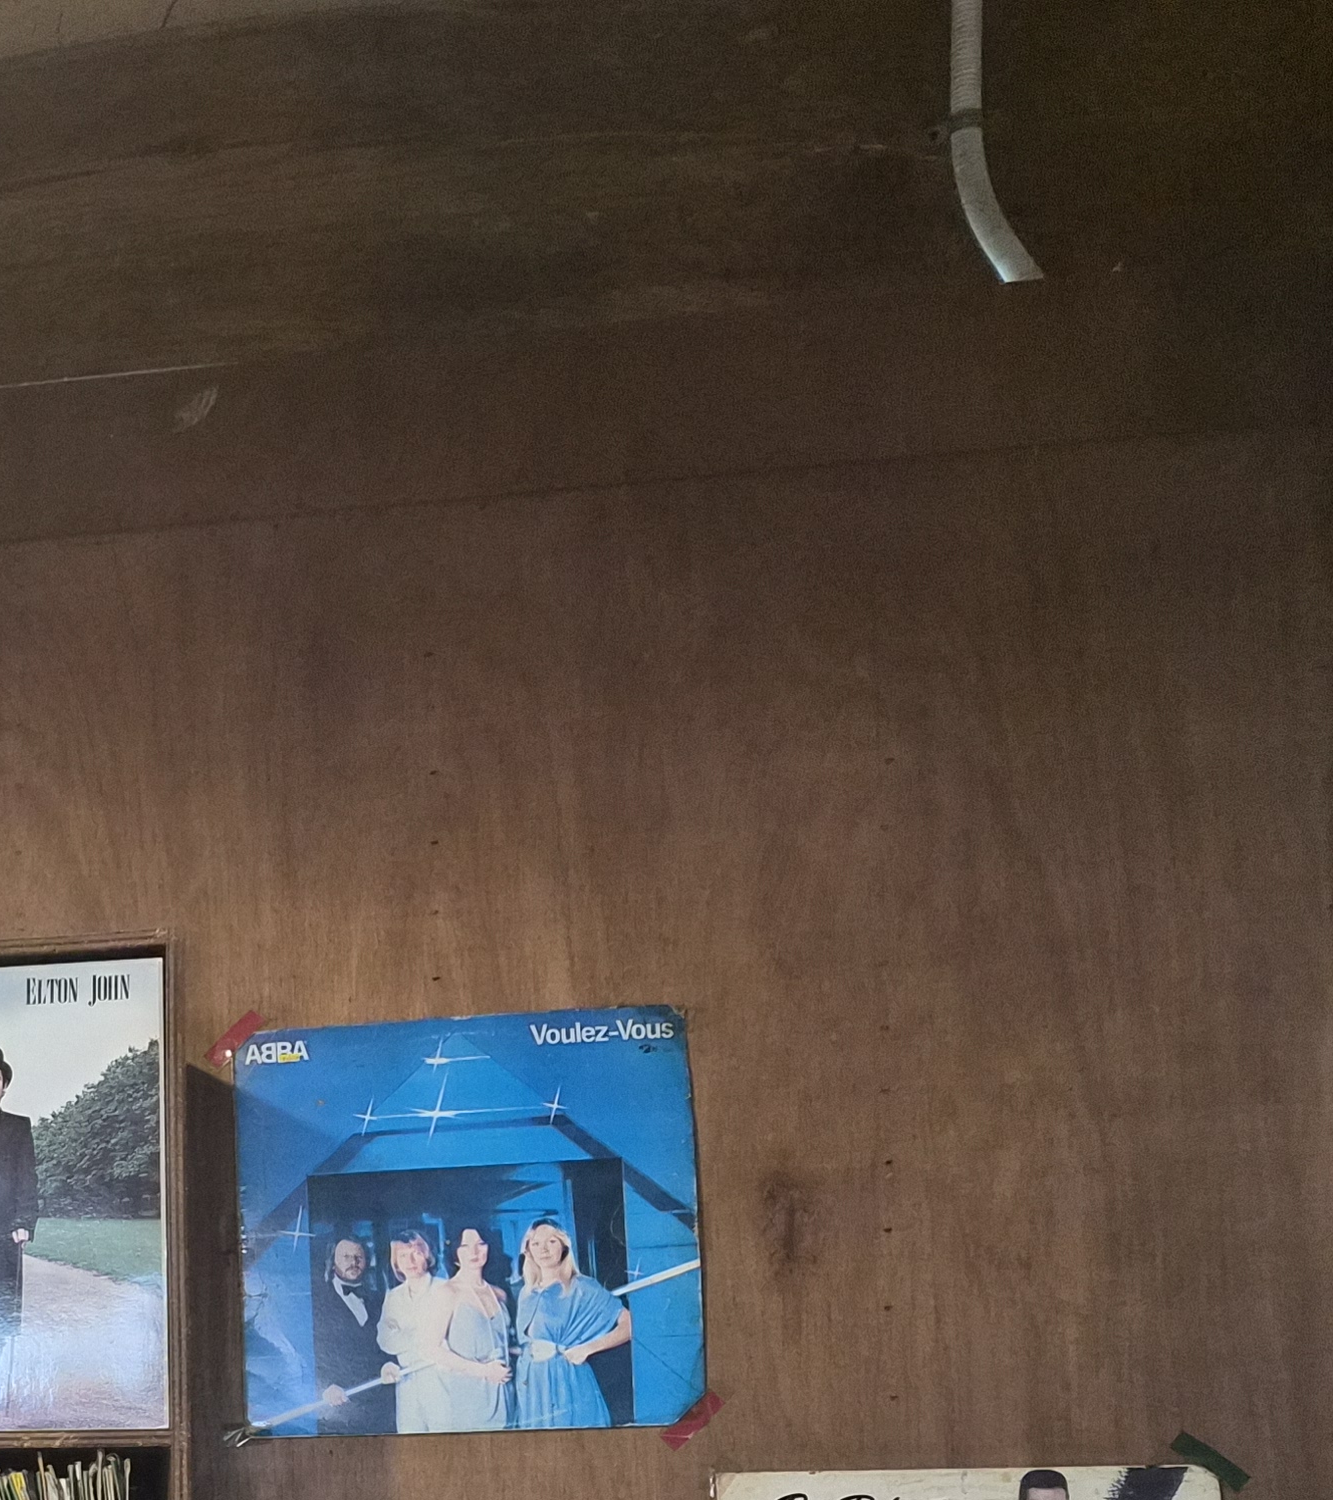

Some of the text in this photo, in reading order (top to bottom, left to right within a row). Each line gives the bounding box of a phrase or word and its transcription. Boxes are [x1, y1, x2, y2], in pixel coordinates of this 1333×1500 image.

[25, 973, 131, 1007] ELTON JOHN
[529, 1018, 675, 1046] Voulez-Vous
[244, 1039, 310, 1066] ABBA
